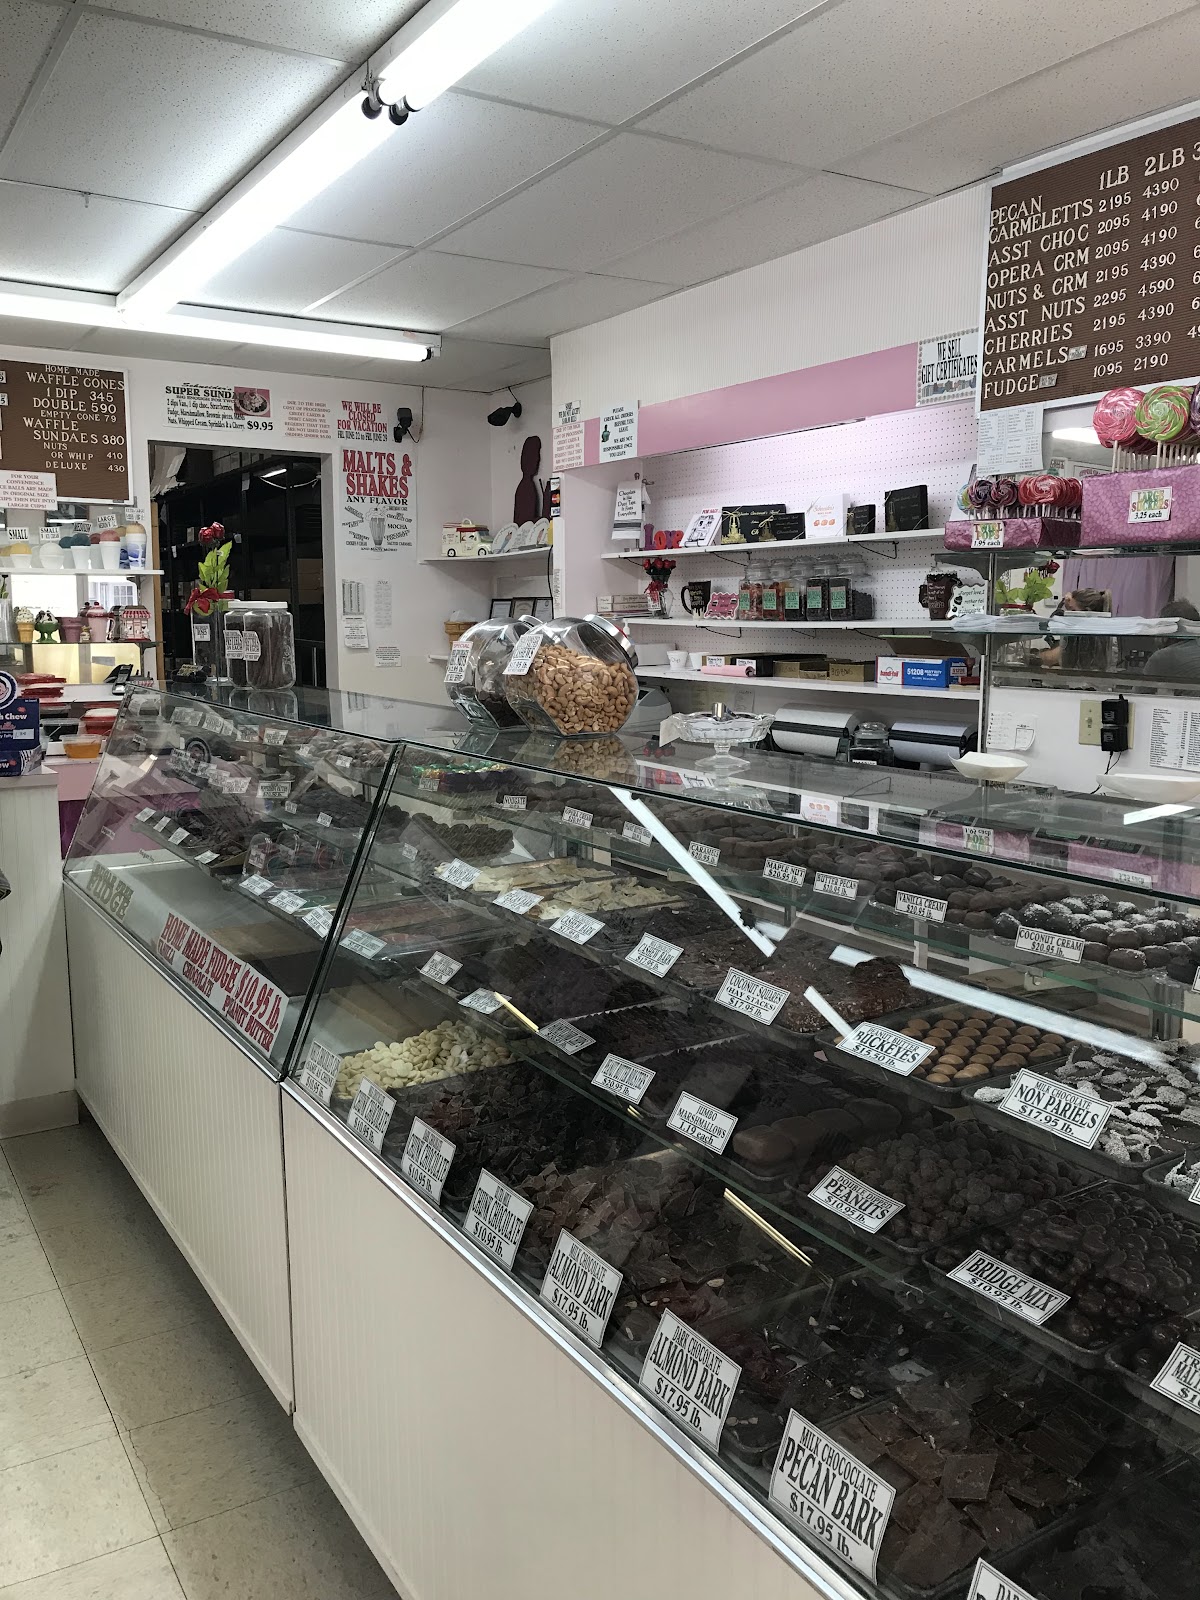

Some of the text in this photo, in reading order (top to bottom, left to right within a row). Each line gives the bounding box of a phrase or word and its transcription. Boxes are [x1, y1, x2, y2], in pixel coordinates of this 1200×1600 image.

[1099, 165, 1130, 191] 1LB
[1144, 147, 1185, 176] 2LB
[988, 178, 1180, 244] CARMELETTS 2195 4390
[990, 195, 1043, 228] PECAN
[988, 201, 1178, 267] ASST CHOC 2095 4190
[988, 226, 1178, 289] OPERA CRM 2095 4190
[986, 251, 1176, 312] NUTS & CRM 2195 4390
[984, 277, 1175, 334] ASST NUTS 2295 4590
[984, 302, 1175, 356] CHERRIES 2195 4390
[937, 338, 961, 361] WE SELL
[982, 330, 1171, 378] CARMELS 1695 3390
[26, 372, 125, 391] WAFFLE CONES
[45, 365, 100, 377] HOME MADE
[921, 354, 978, 384] GIFT CERTIFICATES
[984, 352, 1169, 400] FUDGE 1095 2190
[46, 387, 114, 402] 1 DIP 345
[165, 386, 200, 397] SUPER
[33, 397, 117, 414] DOUBLE 590
[40, 410, 117, 423] EMPTY CONE 79
[342, 400, 381, 413] WE WILL BE
[348, 411, 376, 422] CLOSED
[23, 417, 79, 431] WAFFLE
[247, 420, 274, 431] $9.95
[337, 419, 387, 433] FOR VACATION
[33, 430, 125, 445] SUNDAES 380
[43, 442, 68, 450] NUTS
[45, 461, 125, 473] DELUXE 430
[51, 451, 123, 460] OR WHIP 410
[342, 449, 412, 476] MALTS &
[346, 473, 409, 498] SHAKES
[1137, 490, 1165, 501] LARGE
[370, 497, 408, 506] FLAVOR
[97, 515, 115, 523] LARGE
[1134, 511, 1147, 519] 3.25
[8, 529, 28, 540] SMALL
[907, 668, 924, 676] 51208
[766, 861, 804, 877] MAPLE NUT
[768, 870, 790, 881] $20.95
[817, 874, 839, 888] BUTTER
[86, 873, 131, 920] FUDGE
[822, 884, 840, 895] $20.95
[900, 893, 945, 912] VANILLA CREAM
[906, 903, 925, 915] $20.95
[1019, 929, 1082, 951] COCONUT CREAM
[1031, 942, 1054, 954] $20.95
[161, 913, 274, 1019] HOME MADE FUDGE $10.95
[726, 986, 777, 1011] (HAY STACKS)
[730, 975, 781, 1004] COCONUT SQUARES
[182, 961, 274, 1053] CHOCOLATE PEANUT BUTTER
[728, 997, 753, 1013] $17.95
[852, 1044, 886, 1061] $15.50
[854, 1031, 920, 1063] BUCKEYES
[868, 1028, 920, 1052] PEANUT BUTTER
[602, 1078, 623, 1092] $20.95
[1034, 1081, 1092, 1110] MILK CHOCOLATE
[695, 1105, 718, 1121] JUMBO
[1014, 1083, 1099, 1129] NON PARIELS
[677, 1107, 727, 1139] MARSHMALLOWS
[1018, 1104, 1075, 1136] $17.95 lb.
[679, 1121, 714, 1145] 1.19 each
[824, 1178, 889, 1220] PEANUTS
[837, 1176, 892, 1209] DOUBLE DIPPED
[825, 1195, 866, 1224] $10.95 lb.
[473, 1221, 496, 1249] $10.95
[488, 1200, 523, 1245] CHOCOLATE
[569, 1243, 608, 1283] MILK CHOCOLATE
[550, 1249, 613, 1321] ALMOND BARK
[966, 1258, 1056, 1312] BRIDGE MIX
[966, 1277, 1024, 1312] $10.95 lb.
[552, 1288, 580, 1321] $17.95
[672, 1325, 723, 1376] DARK CHOCOLATE
[650, 1332, 731, 1420] ALMOND BARK
[654, 1377, 702, 1431] $17.95 lb.
[800, 1426, 878, 1502] MILK CHOCOCLATE
[779, 1437, 883, 1551] PECAN BARK
[789, 1492, 853, 1561] $17.95 lb.
